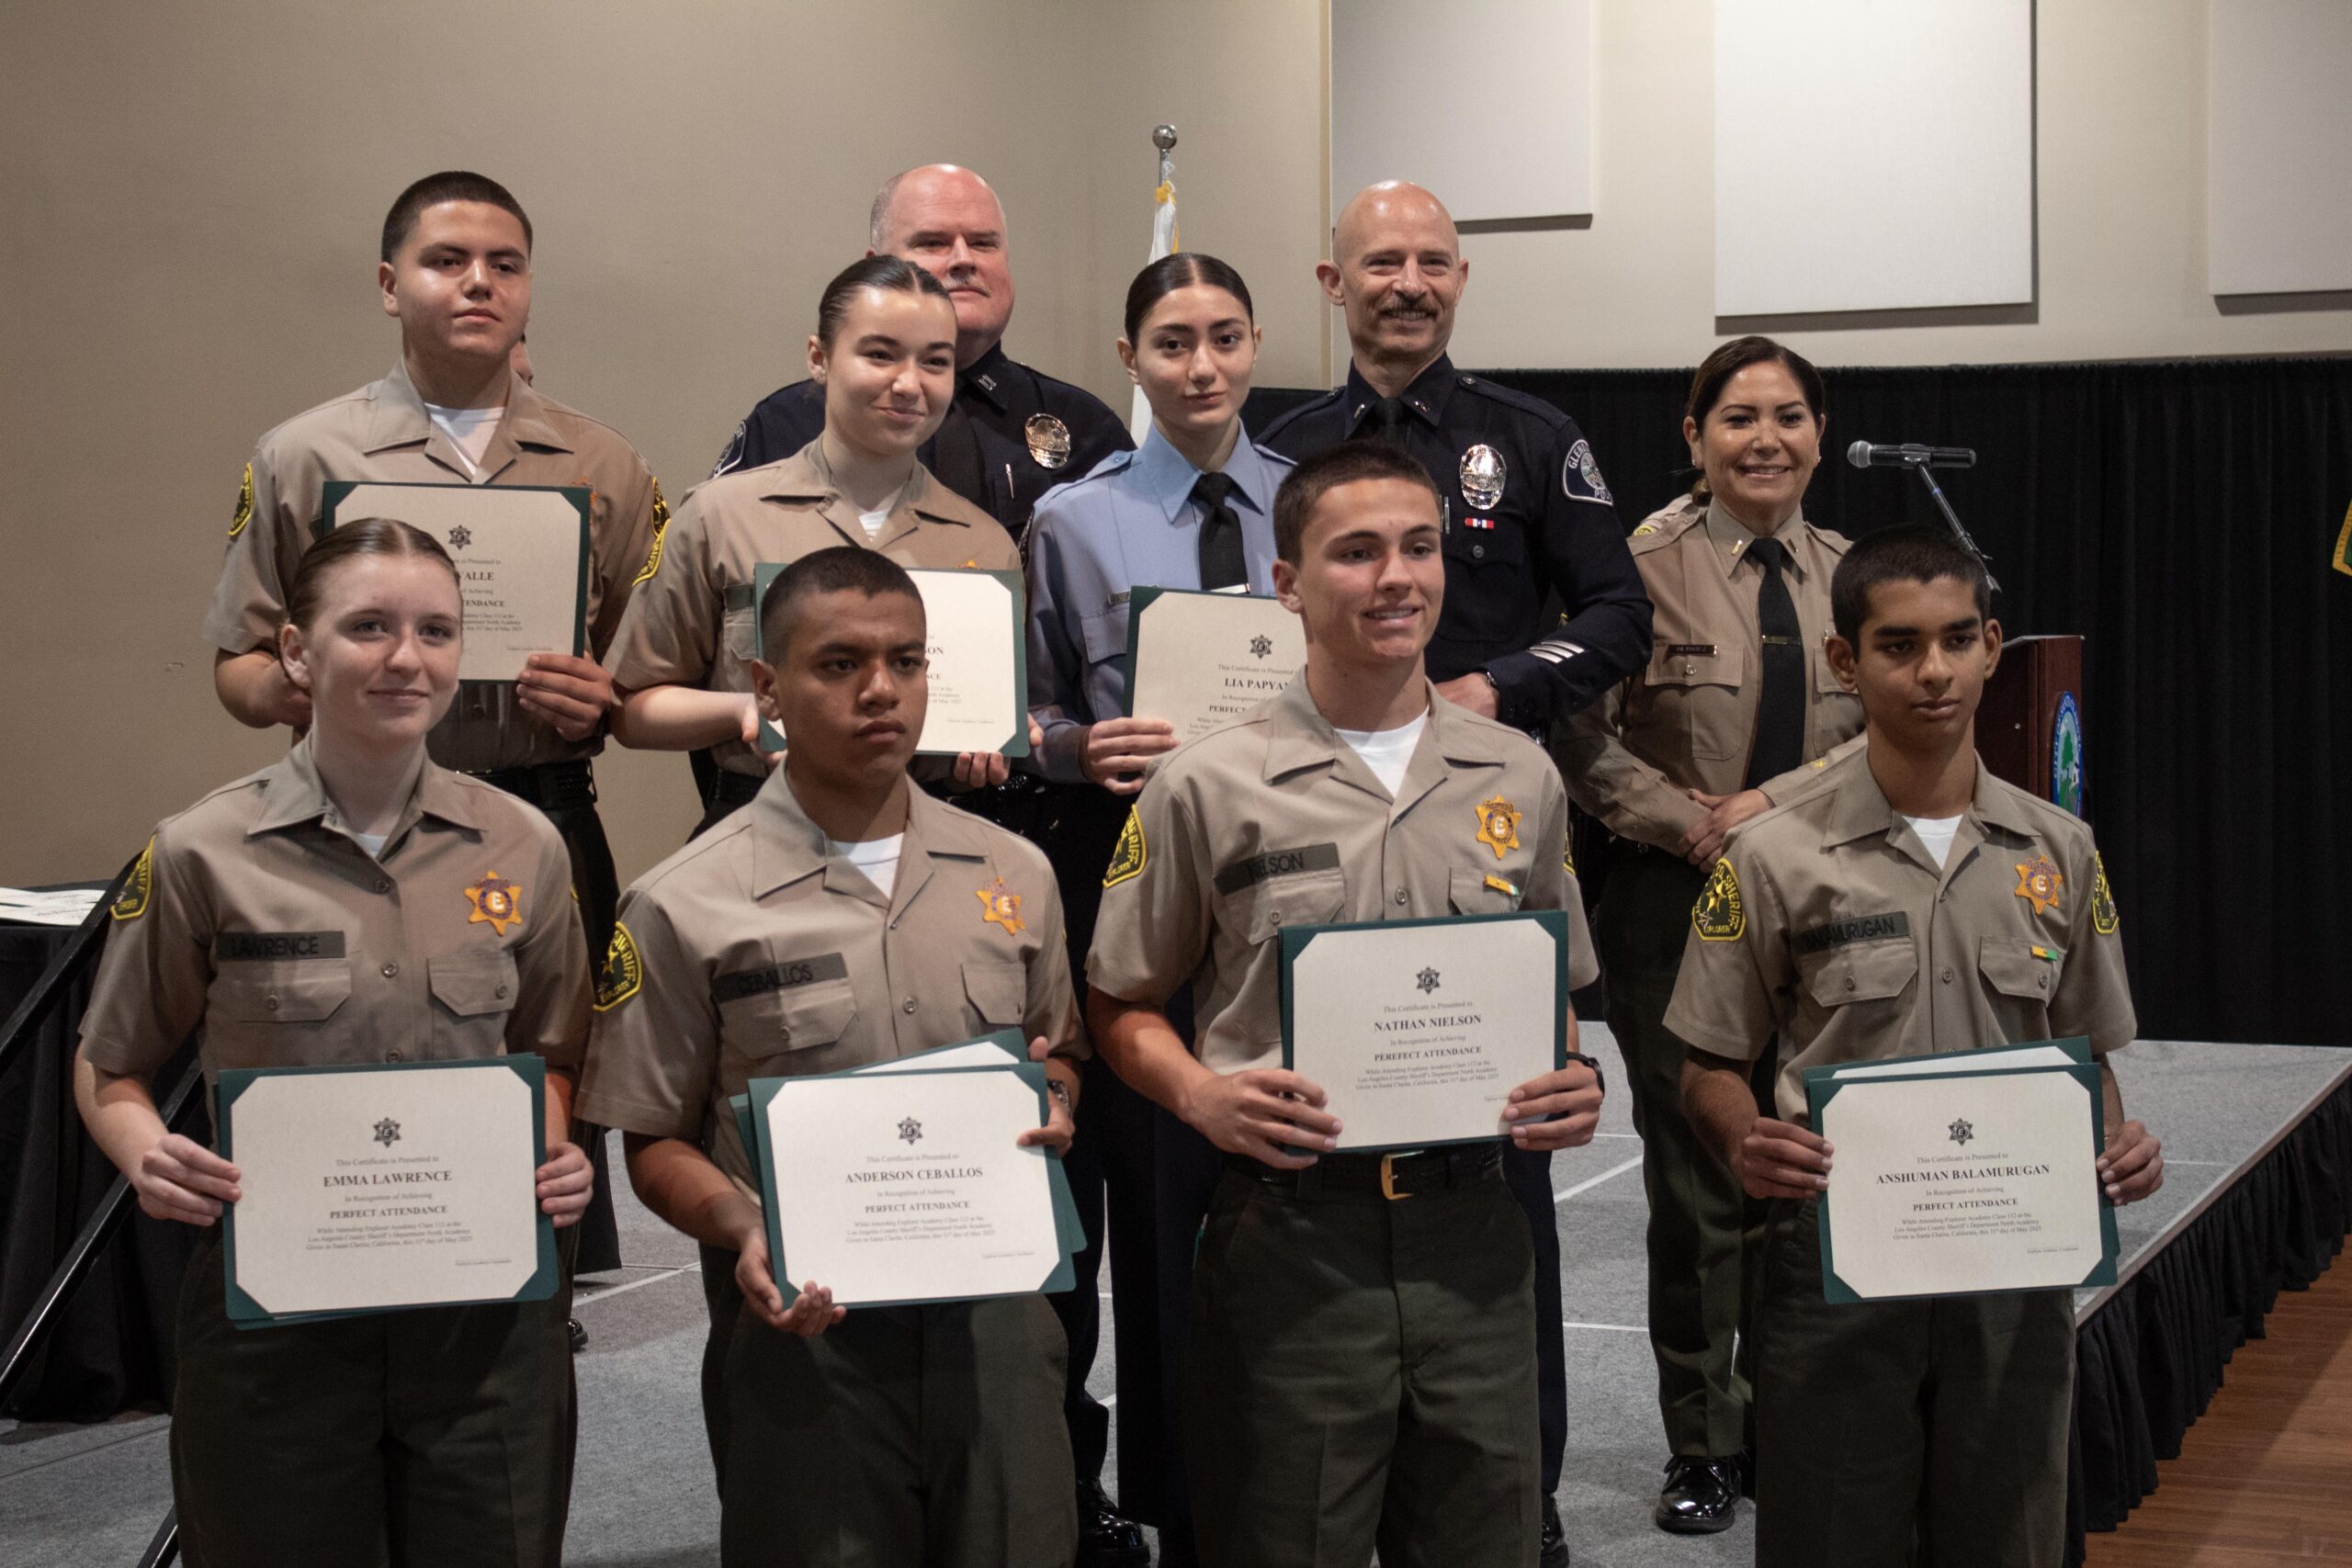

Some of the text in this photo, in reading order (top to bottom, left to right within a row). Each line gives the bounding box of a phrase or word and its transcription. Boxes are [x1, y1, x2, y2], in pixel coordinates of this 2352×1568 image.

[462, 571, 494, 581] ALLE
[1225, 678, 1288, 691] LIA PAPYA
[1495, 816, 1506, 835] E
[2036, 874, 2047, 892] E
[492, 891, 504, 910] E
[1374, 1014, 1482, 1032] NATHAN NIELSON
[1423, 1045, 1482, 1058] ATTENDANCE
[1917, 1156, 1930, 1164] This
[1931, 1155, 1964, 1164] Certificate
[1971, 1153, 2001, 1161] Presented
[323, 1170, 452, 1188] EMMA LAWRENCE
[845, 1167, 984, 1184] ANDERSON CEBALLOS
[1876, 1164, 2051, 1184] ANSHUMAN BALAMURUGAN
[330, 1205, 448, 1220] PERFECT ATTENDANCE
[865, 1201, 971, 1214] PERFECT ATTENDANCE
[1913, 1198, 2018, 1213] PERFECT ATTENDANCE
